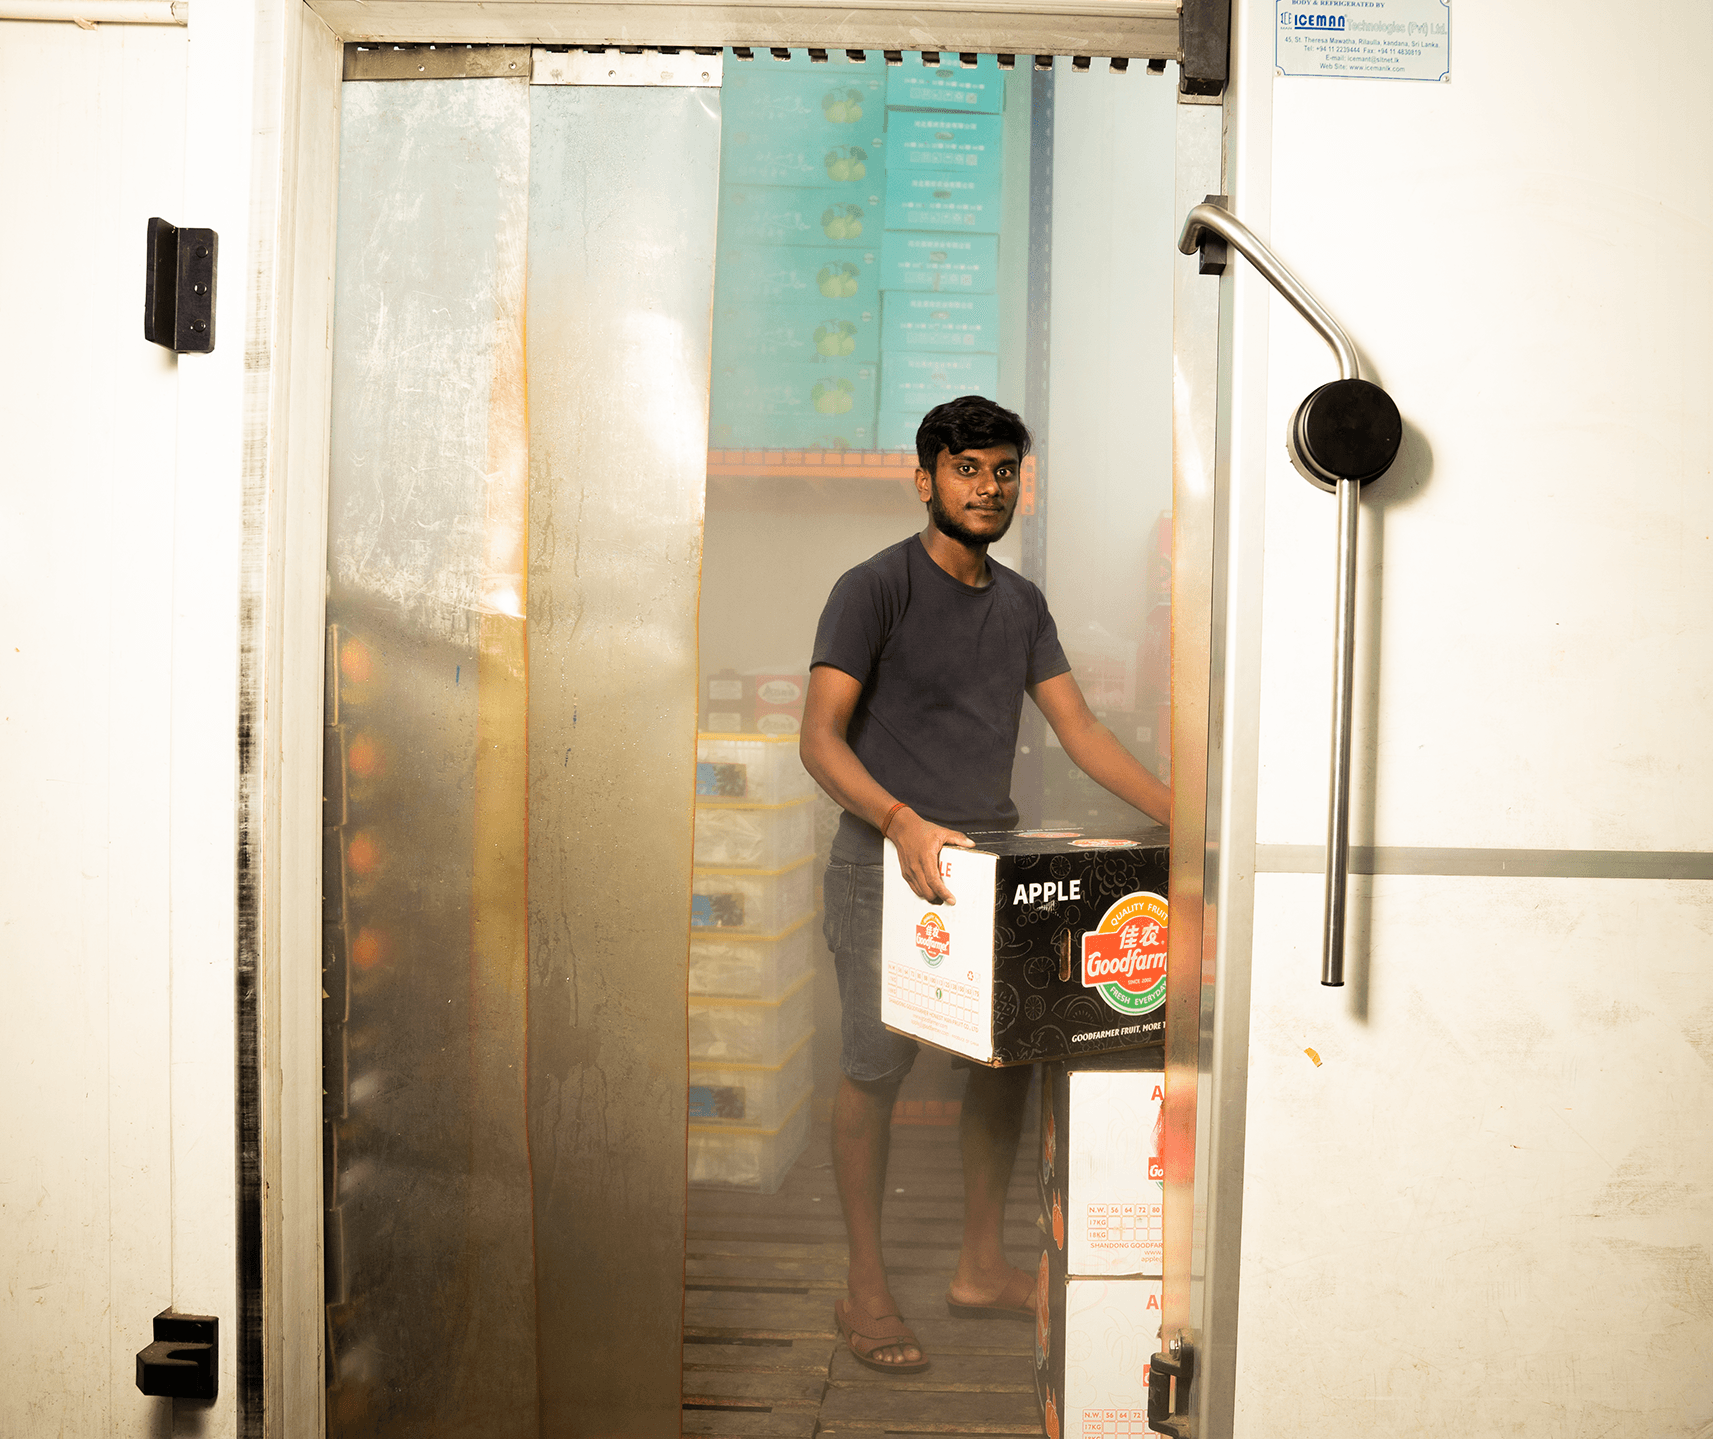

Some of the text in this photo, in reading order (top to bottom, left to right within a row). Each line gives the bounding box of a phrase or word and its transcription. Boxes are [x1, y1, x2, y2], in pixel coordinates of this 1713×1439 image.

[1294, 14, 1345, 28] ICEMAN
[1346, 18, 1406, 35] Technologies
[1430, 22, 1448, 35] Ltd.
[1304, 36, 1328, 44] Theresa
[1013, 879, 1082, 905] APPLE
[1110, 902, 1145, 927] QUALITY
[916, 932, 950, 953] Goodfarmer
[1119, 922, 1160, 950] 佳农
[1087, 948, 1168, 978] Goodfarm
[1109, 980, 1167, 1006] FRESH EVERYDAY
[1071, 1027, 1120, 1043] GOODFARMER
[1121, 1024, 1141, 1035] FRUIT,
[1142, 1021, 1162, 1032] MORE
[1089, 1206, 1106, 1214] N.W.
